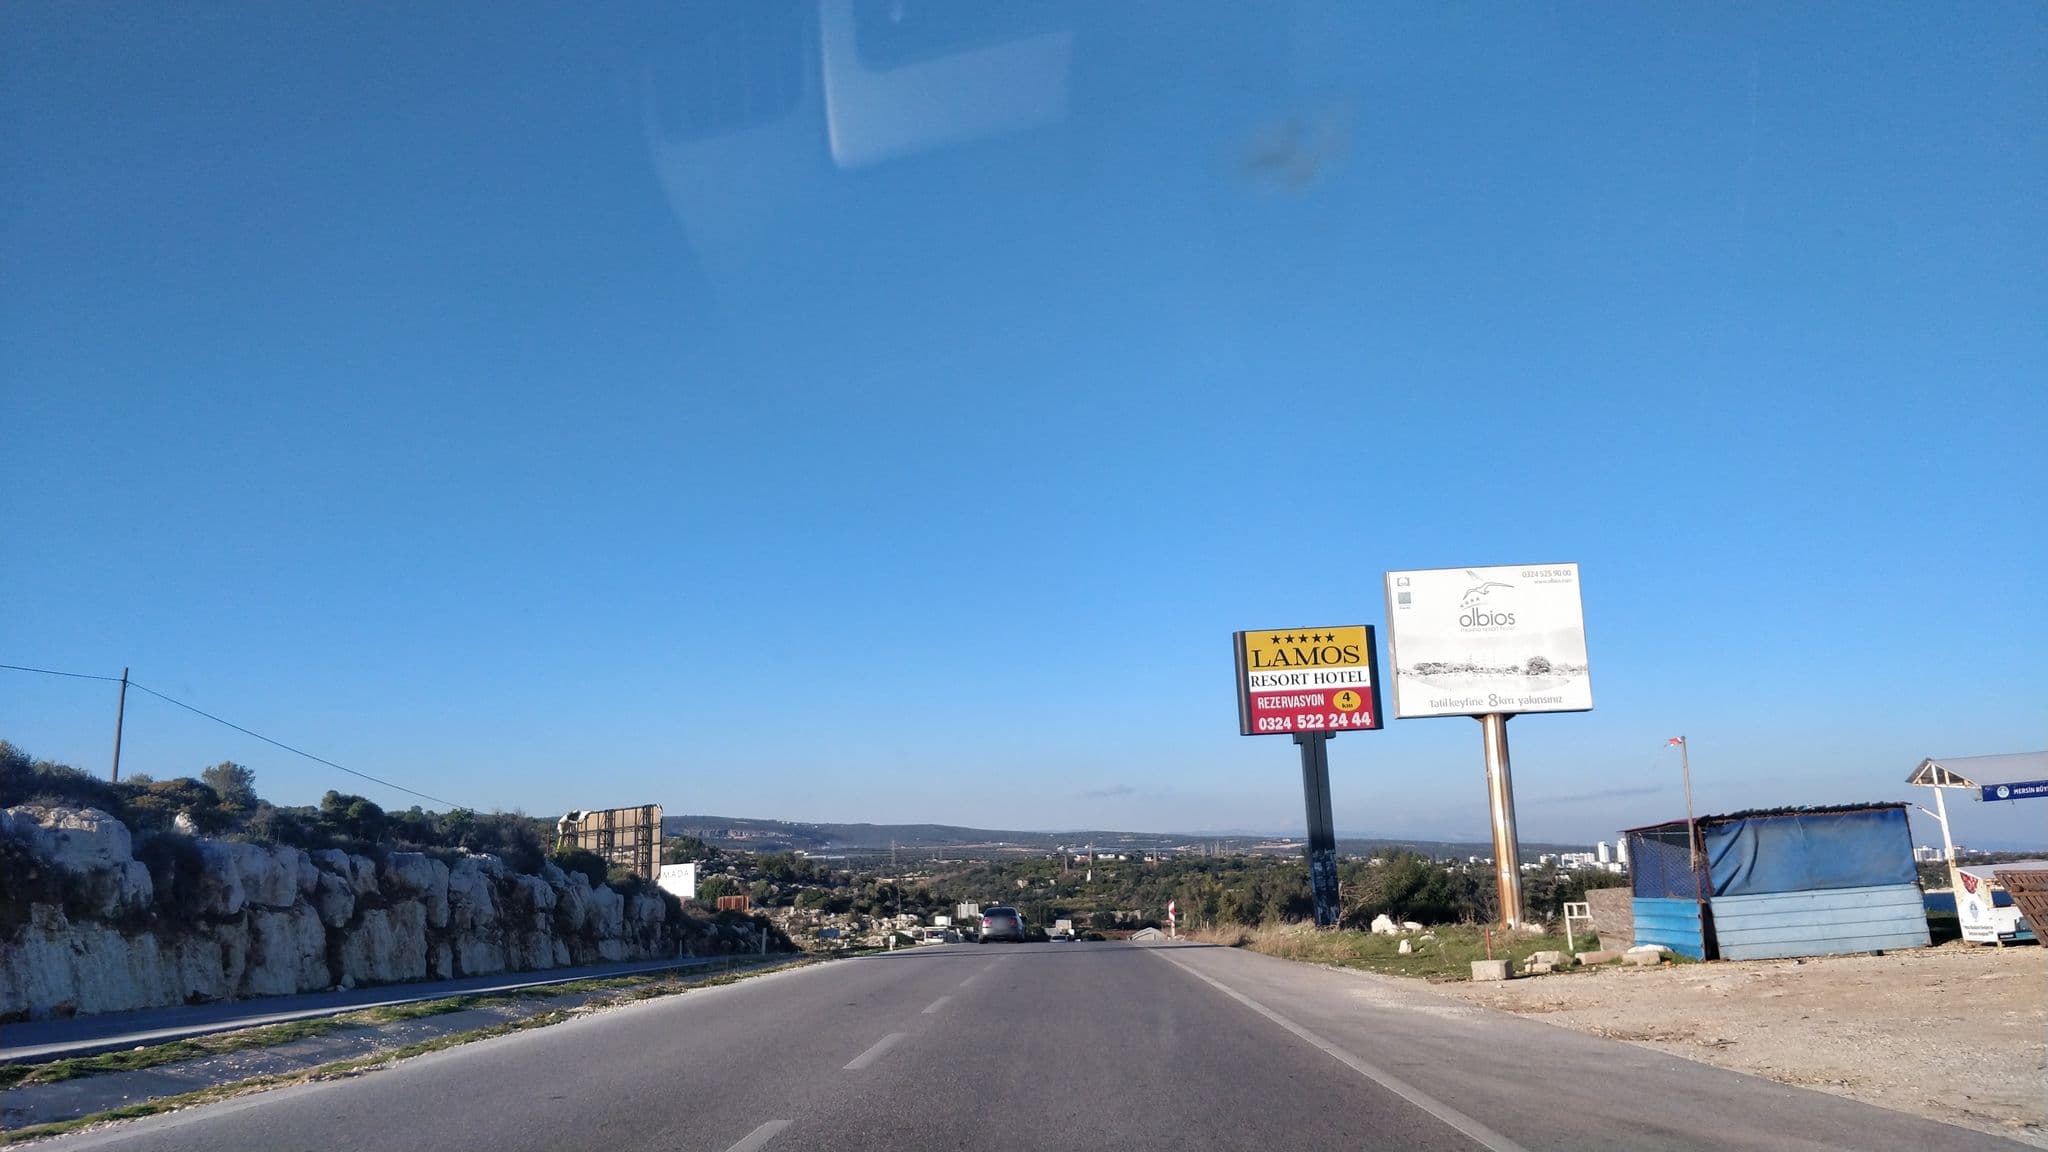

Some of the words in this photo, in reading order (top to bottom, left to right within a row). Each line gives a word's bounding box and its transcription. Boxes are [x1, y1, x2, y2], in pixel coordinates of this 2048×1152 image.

[1460, 607, 1515, 627] olbios
[1252, 645, 1360, 668] LAMOS
[1251, 673, 1310, 688] RESORT
[1314, 670, 1367, 685] HOTEL
[1258, 694, 1325, 709] REZERVASYON
[1342, 692, 1351, 702] 4
[1258, 717, 1292, 730] 0324
[1297, 714, 1324, 728] 522
[1329, 713, 1348, 727] 24
[1352, 712, 1371, 726] 44
[2036, 785, 2048, 793] BÜY
